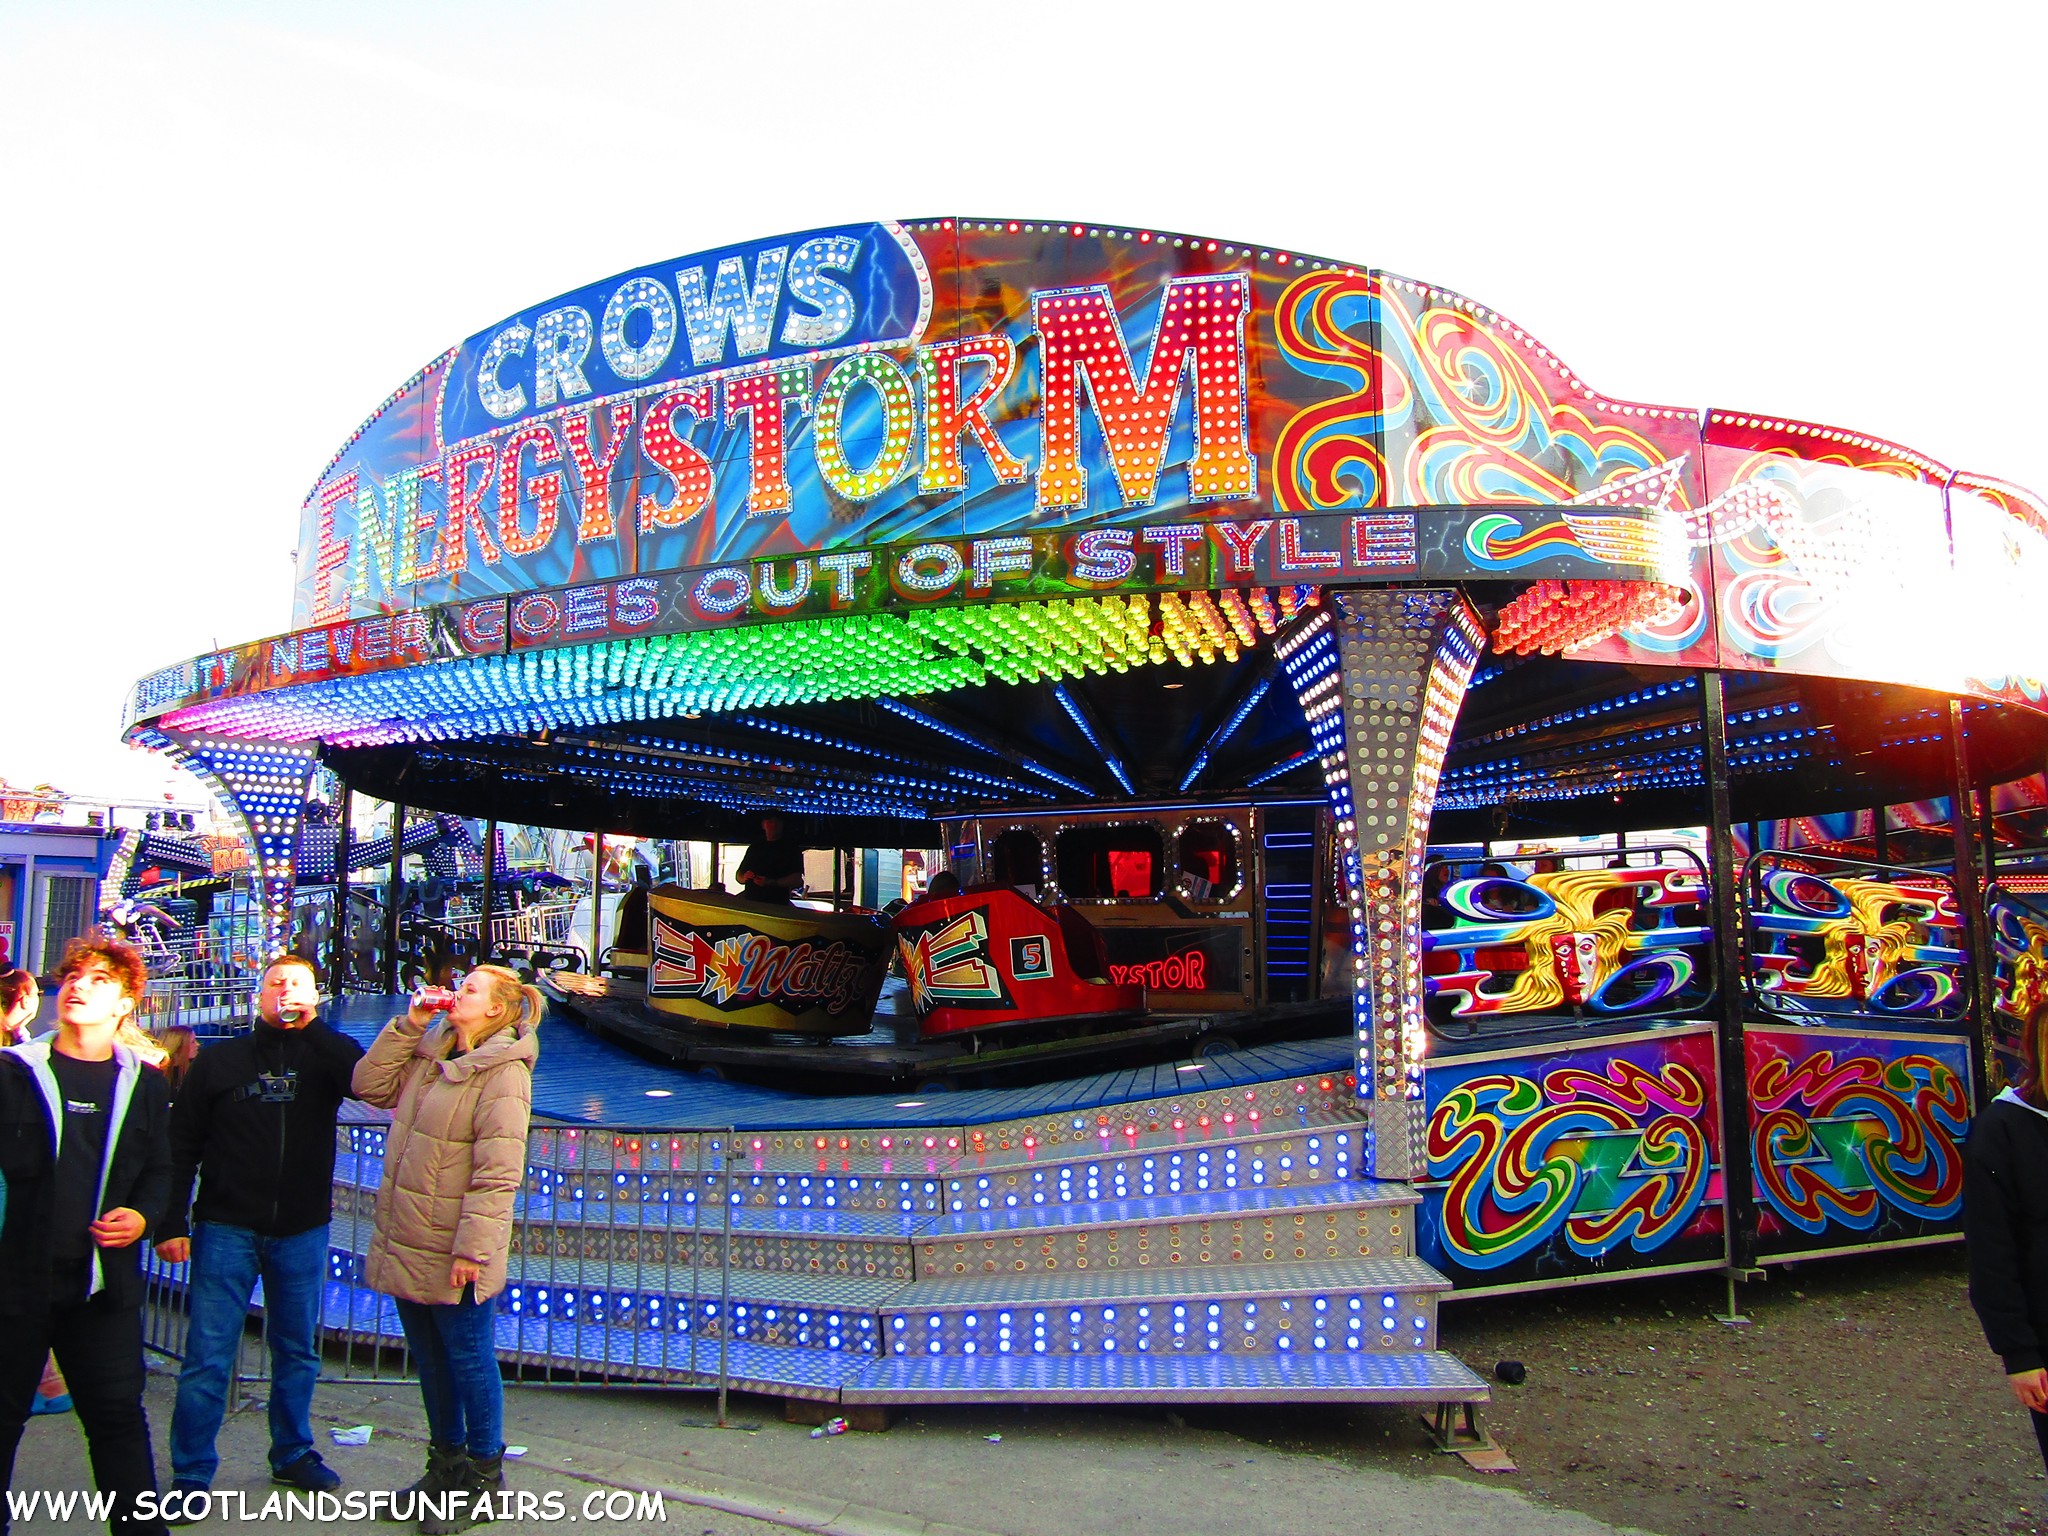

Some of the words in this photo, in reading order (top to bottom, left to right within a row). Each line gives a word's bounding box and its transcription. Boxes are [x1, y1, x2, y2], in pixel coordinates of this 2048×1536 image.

[476, 235, 861, 419] CROWS
[308, 271, 1258, 625] ENERGYSTORM
[270, 612, 431, 675] NEVER
[462, 577, 661, 644] GOES
[694, 551, 873, 614] OUT
[898, 537, 1033, 591] OF
[1074, 513, 1417, 583] STYLE
[1022, 943, 1041, 970] 5
